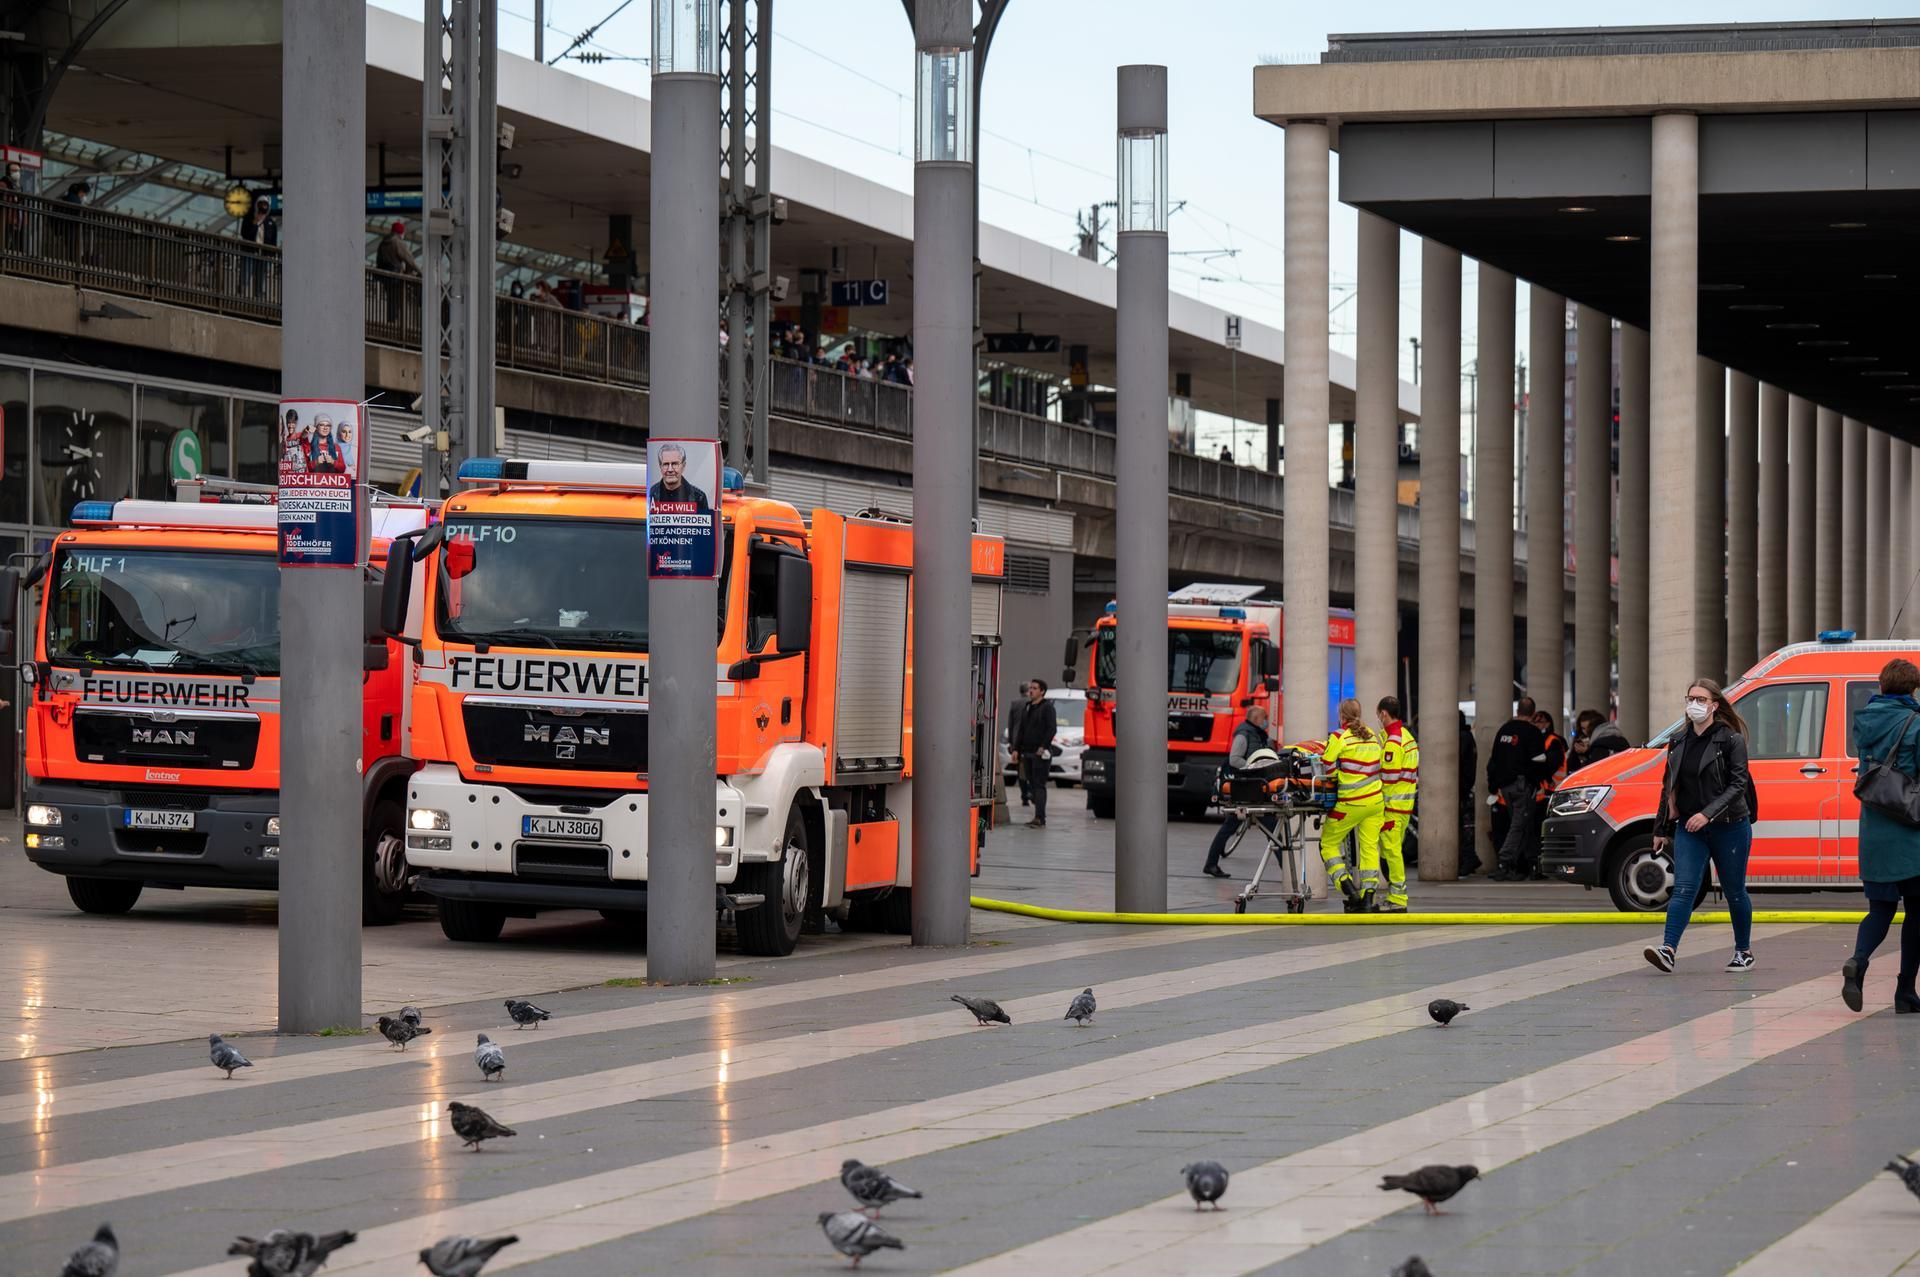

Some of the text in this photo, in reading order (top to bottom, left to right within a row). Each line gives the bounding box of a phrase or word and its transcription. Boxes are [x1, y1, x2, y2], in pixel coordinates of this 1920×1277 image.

[842, 280, 884, 300] 11 C
[1227, 316, 1239, 336] H
[179, 437, 197, 480] S
[328, 490, 349, 498] EUCH
[660, 503, 674, 511] ICH
[675, 504, 695, 512] WILL
[292, 513, 314, 521] KANN!
[672, 516, 710, 525] WERDEN.
[445, 525, 517, 543] PTLF 10
[665, 528, 702, 536] ANDEREN
[702, 528, 711, 536] ES
[286, 539, 332, 547] TODENHÖFER
[659, 536, 693, 545] KÖNNEN!
[62, 557, 126, 573] 4 HLF 1
[83, 679, 250, 708] FEUERWEHR
[132, 728, 195, 745] MAN
[524, 724, 610, 745] MAN
[145, 769, 180, 781] Lentner
[136, 812, 189, 826] K LN 374
[531, 819, 598, 835] K LN 3806
